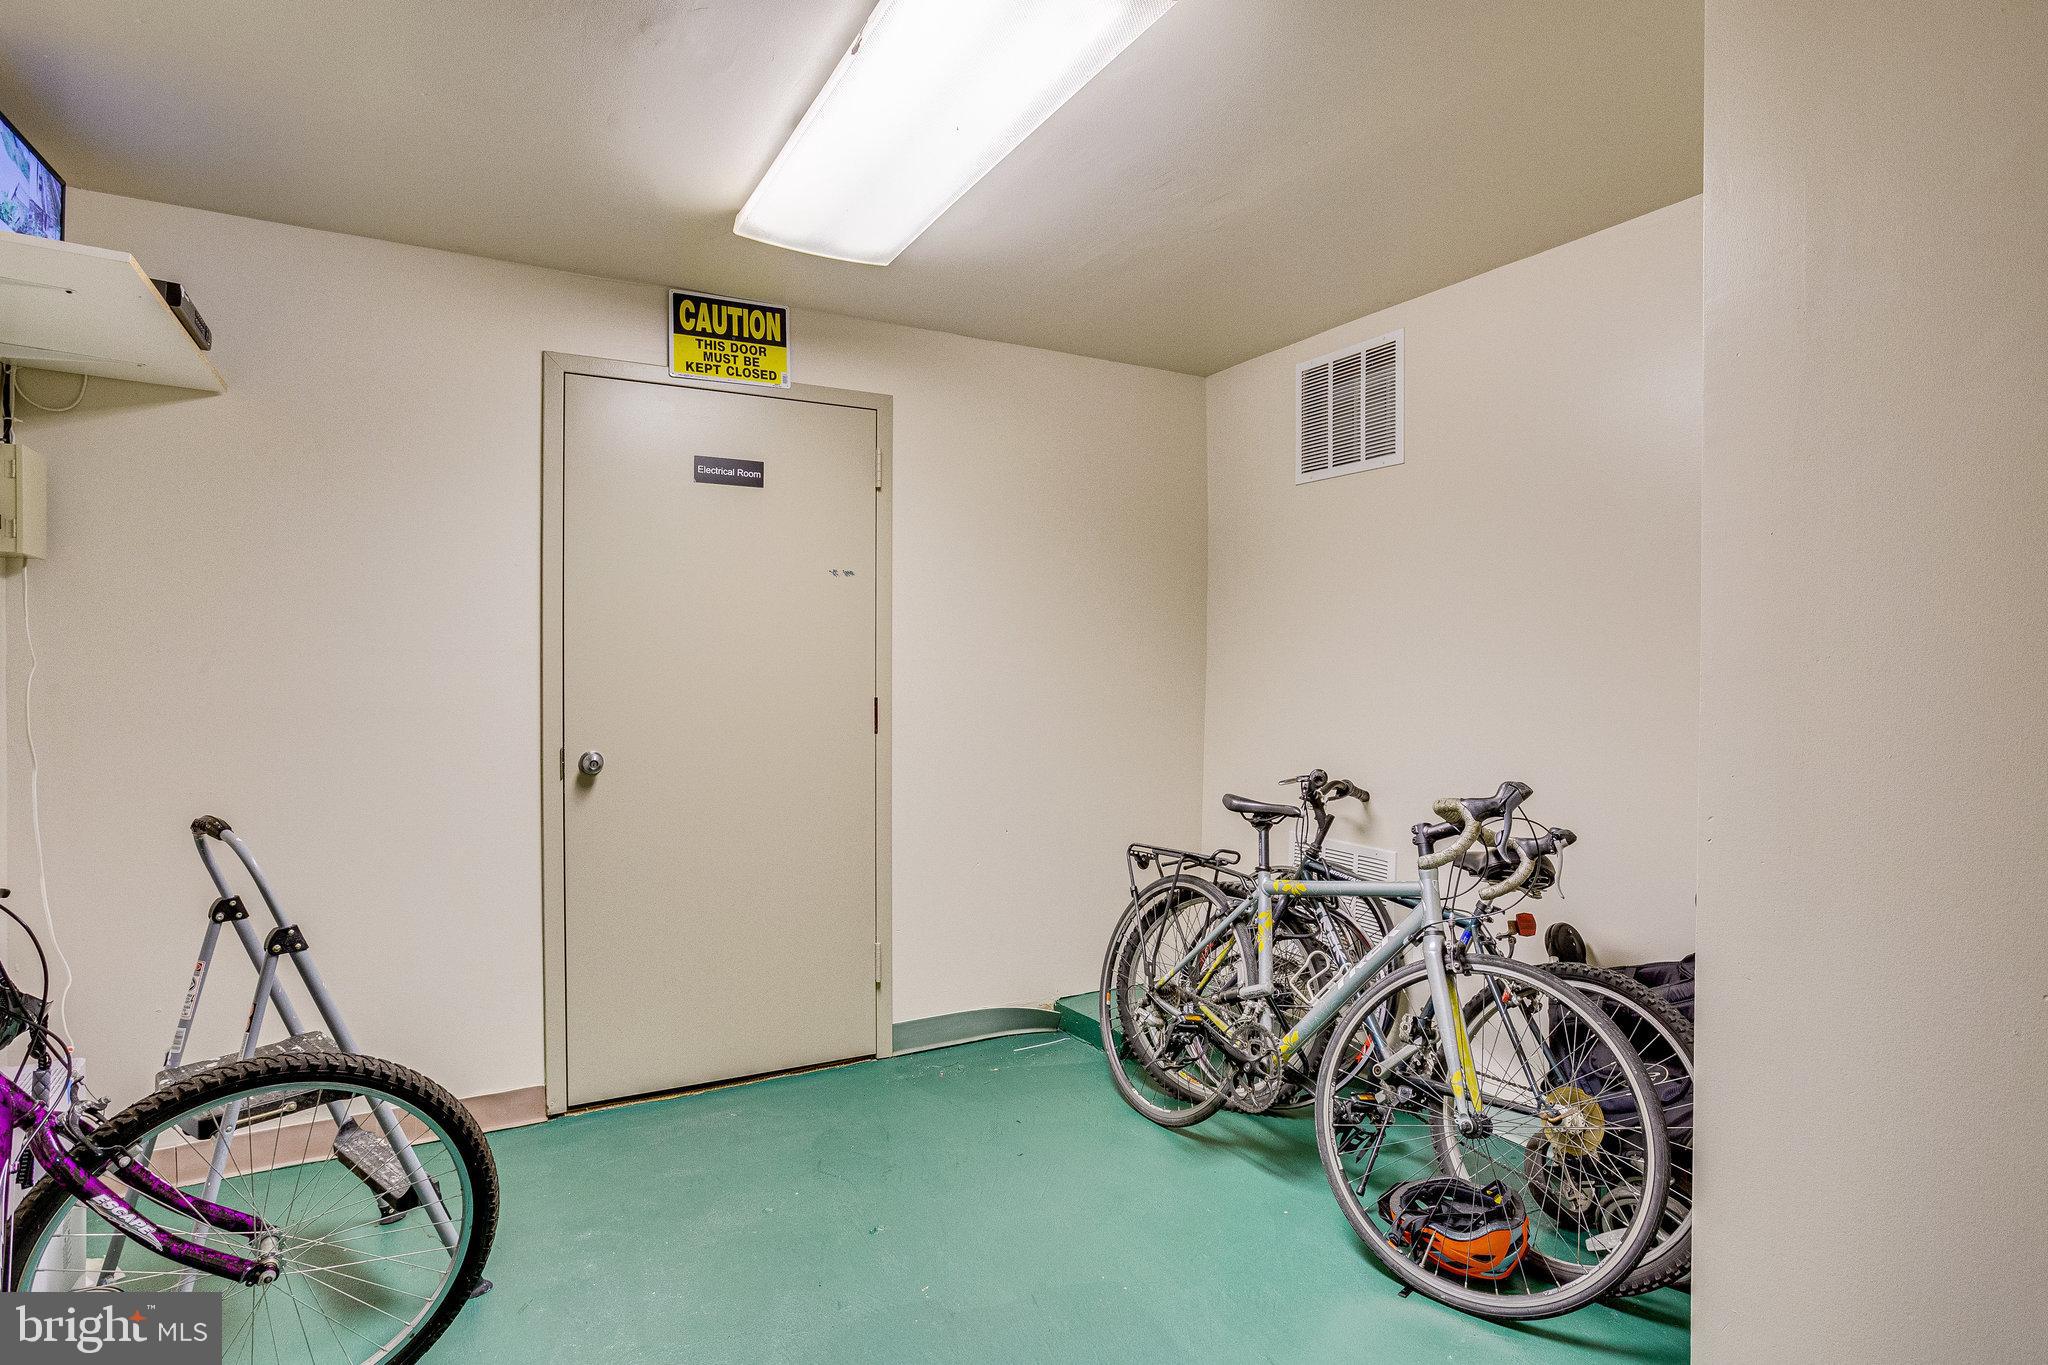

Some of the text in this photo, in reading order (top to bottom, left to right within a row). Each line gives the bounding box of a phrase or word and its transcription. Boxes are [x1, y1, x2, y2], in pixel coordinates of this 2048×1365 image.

[679, 299, 781, 342] CAUTION
[695, 338, 767, 357] THIS DOOR
[703, 351, 760, 368] MUST BE
[685, 361, 722, 375] KEPT
[726, 366, 778, 381] CLOSED
[697, 465, 762, 478] Electrical Room
[1329, 869, 1362, 882] MOUNTA
[92, 1194, 157, 1235] ESCAPE
